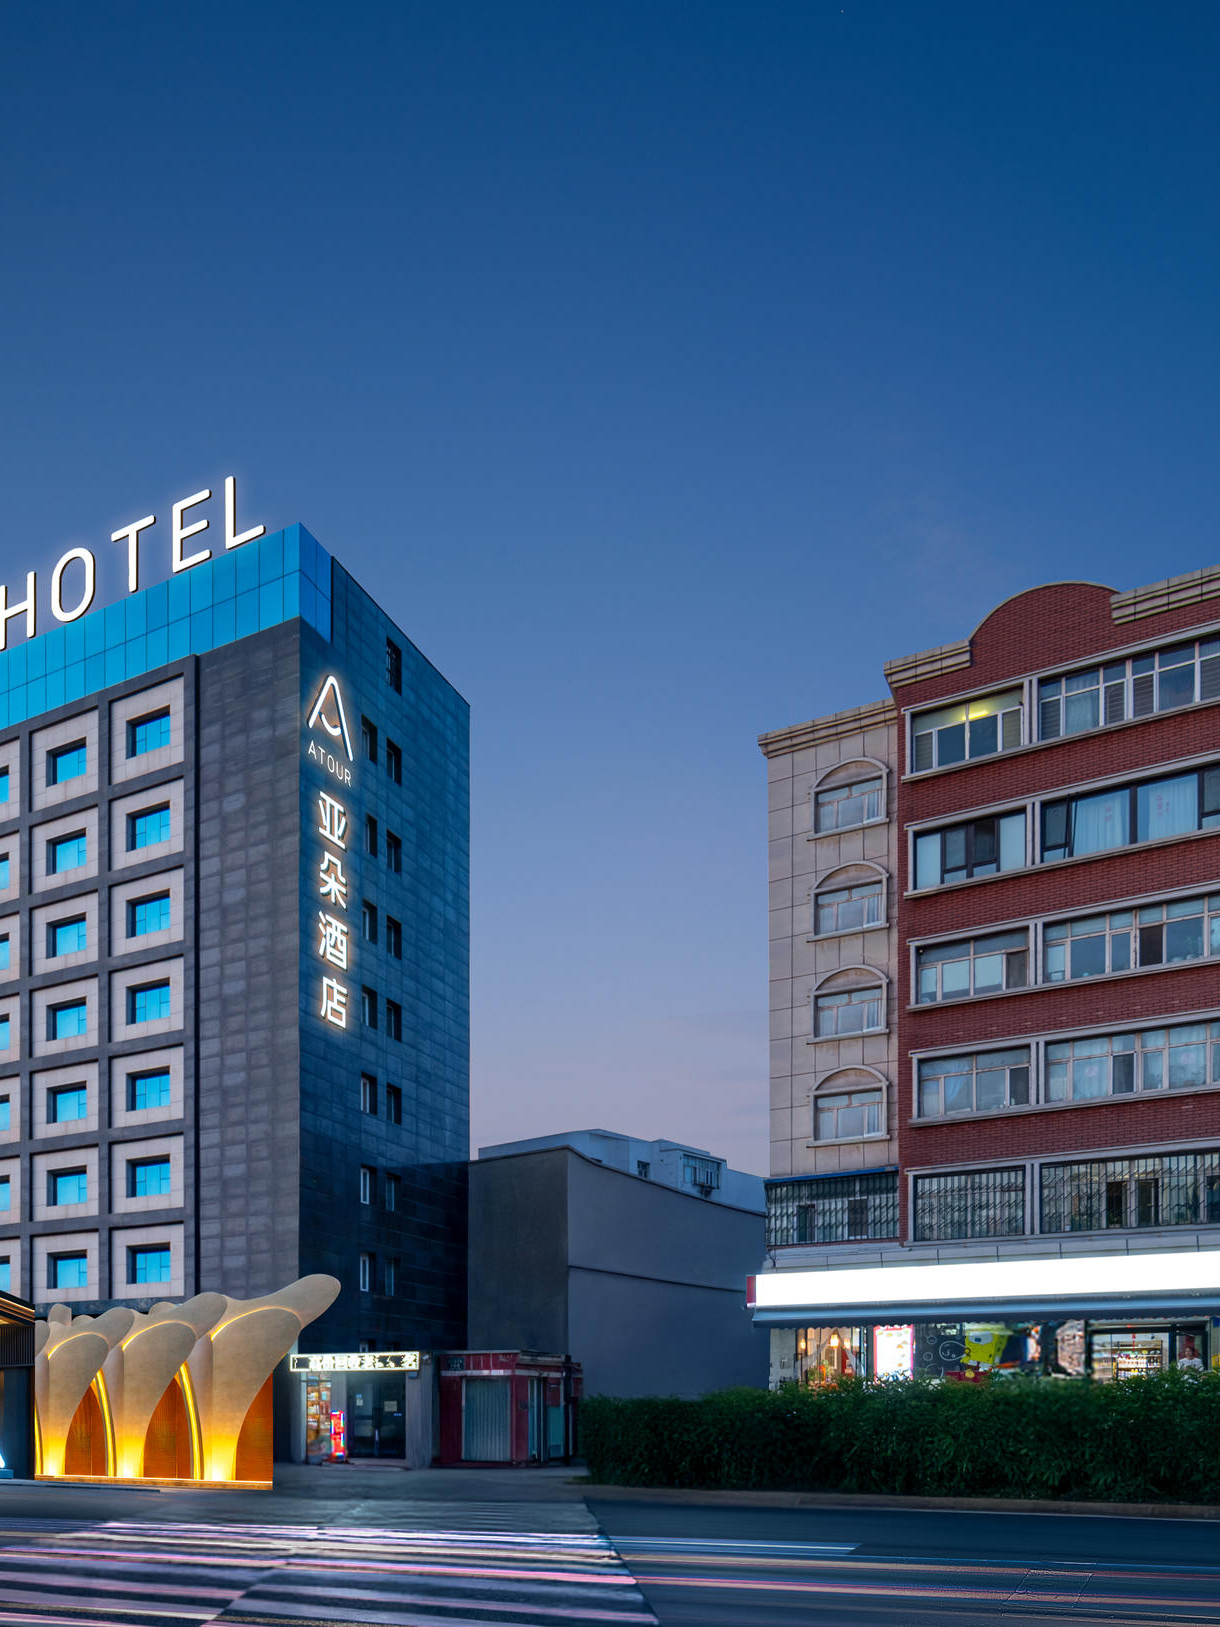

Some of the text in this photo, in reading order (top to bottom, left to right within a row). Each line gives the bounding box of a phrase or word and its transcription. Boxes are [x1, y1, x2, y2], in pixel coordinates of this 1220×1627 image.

[307, 740, 352, 787] ATOUR
[318, 791, 347, 1029] 亚朵酒店
